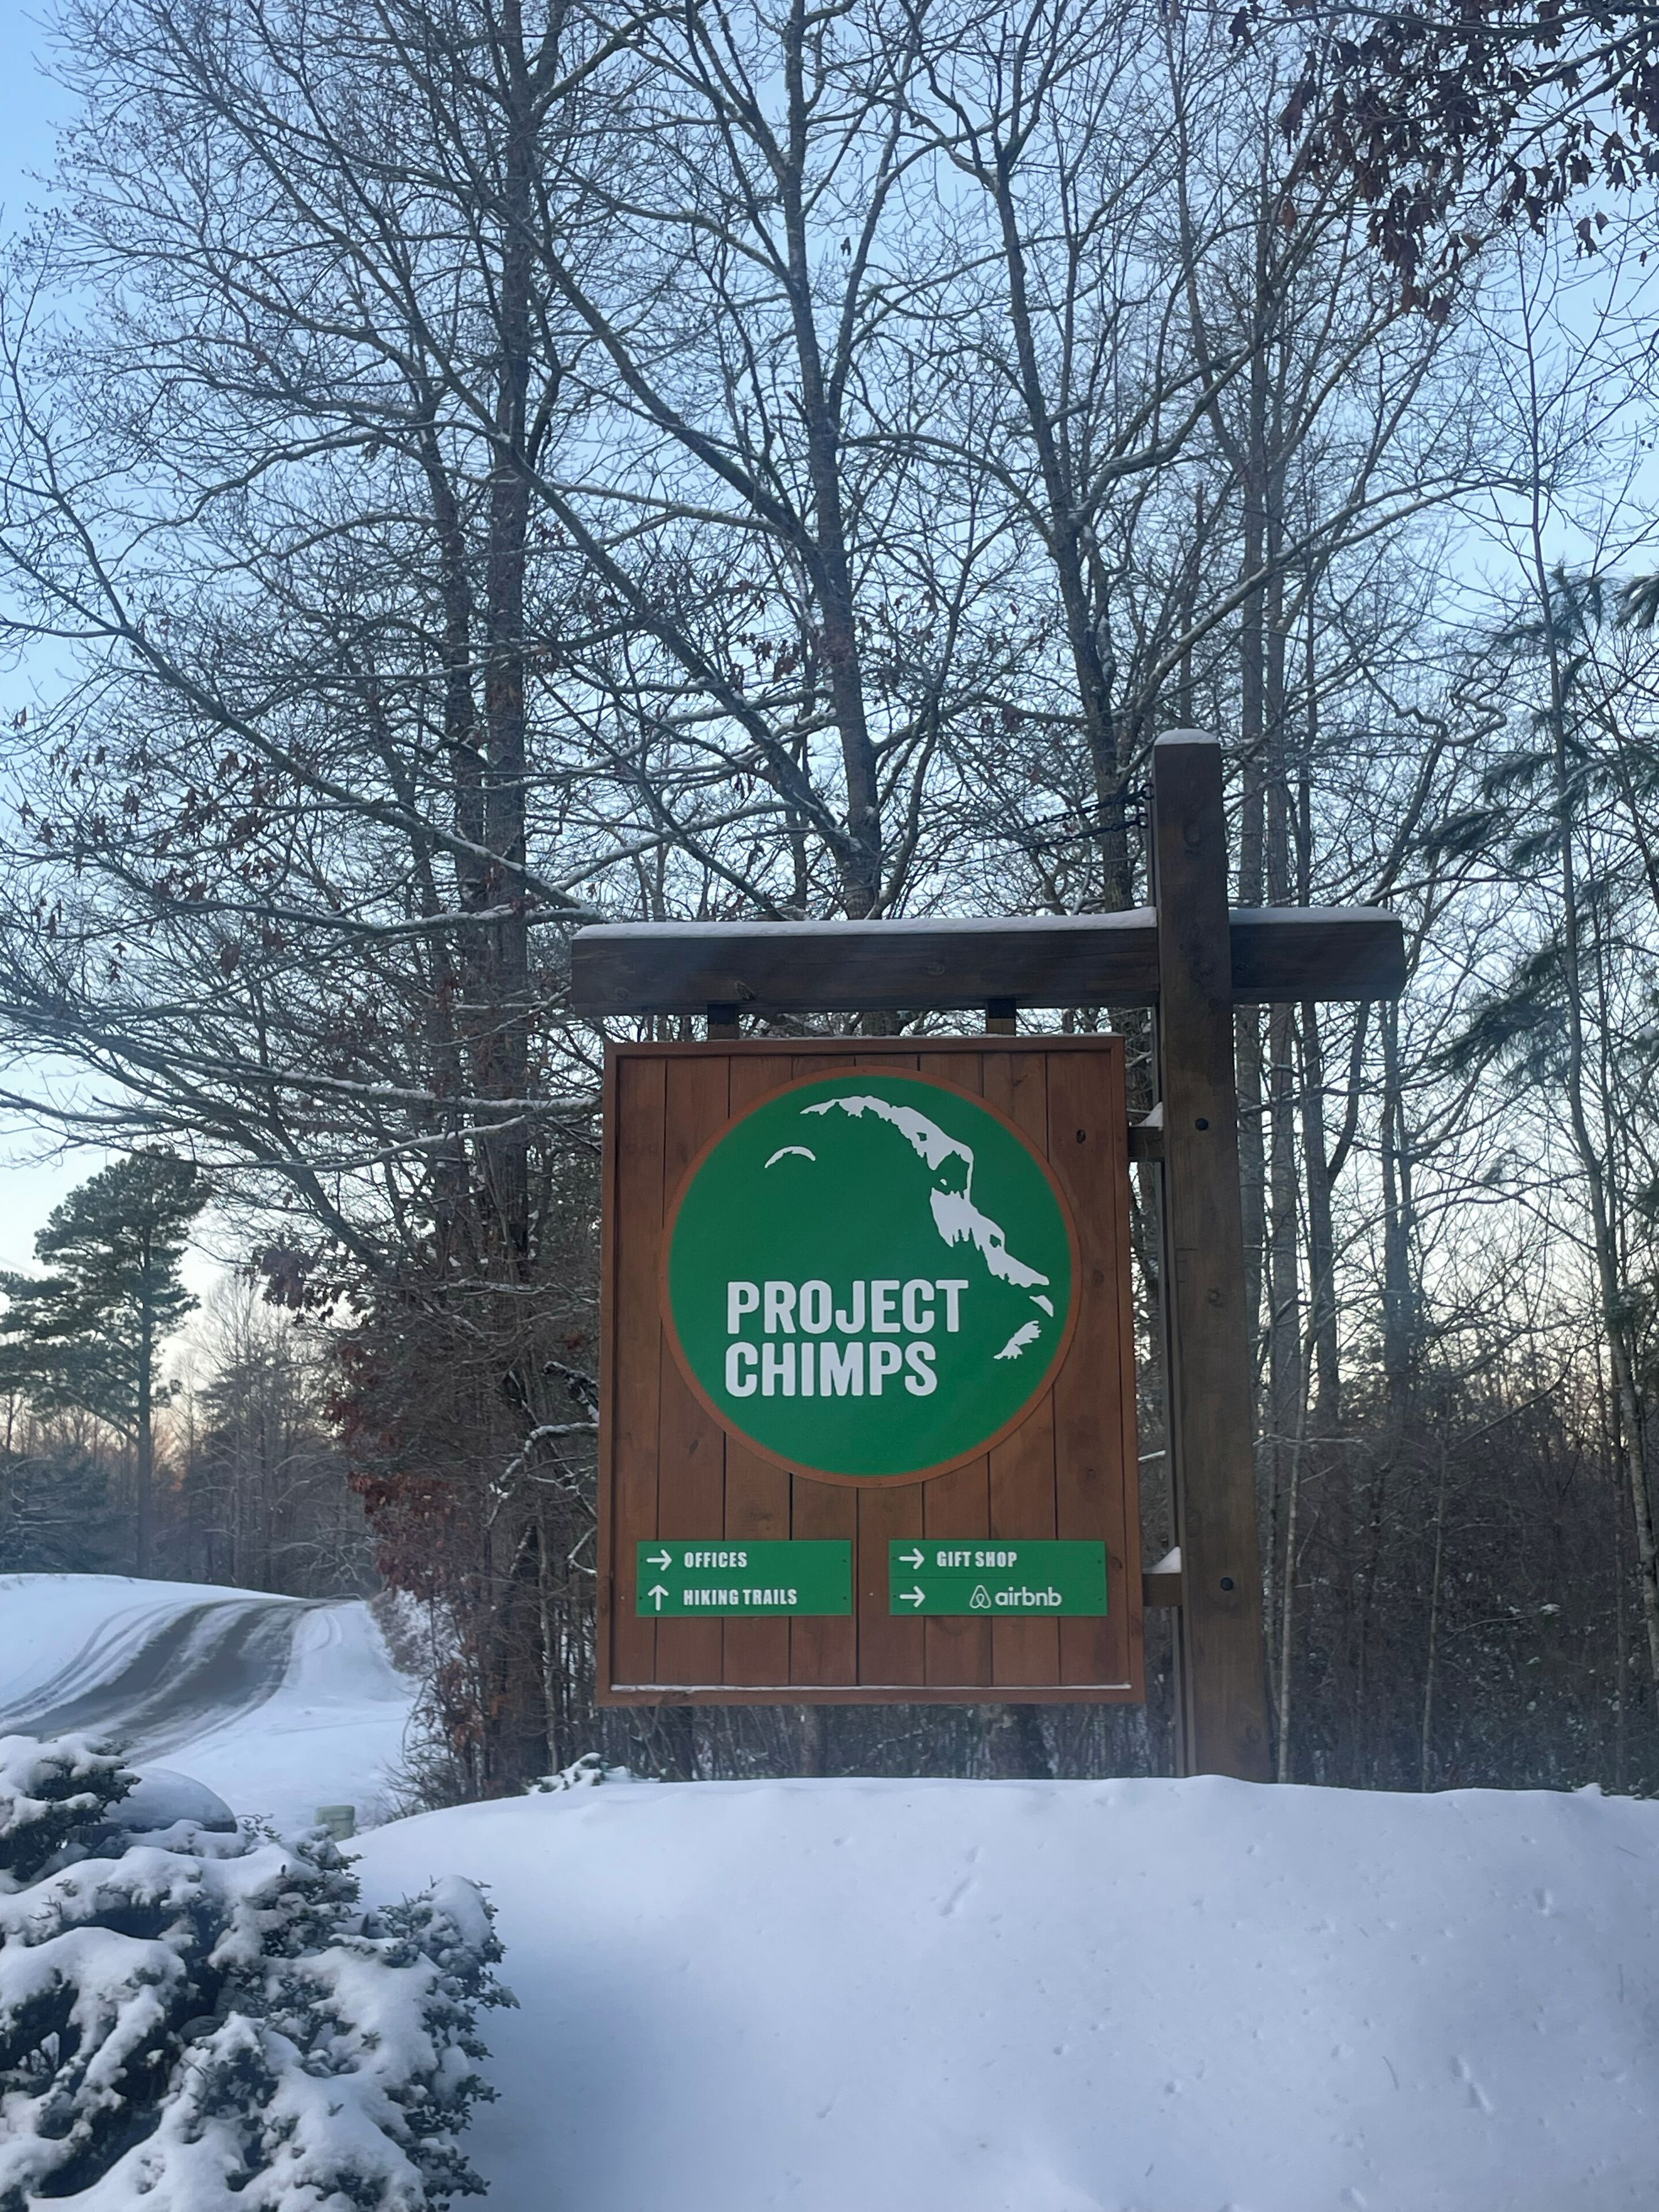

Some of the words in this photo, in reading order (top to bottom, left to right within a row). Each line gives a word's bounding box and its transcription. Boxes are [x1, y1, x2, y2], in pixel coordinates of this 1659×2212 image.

[728, 1279, 968, 1334] PROJECT
[726, 1342, 937, 1396] CHIMPS
[685, 1552, 747, 1567] OFFICES
[937, 1551, 971, 1566] GIFT
[975, 1552, 1017, 1567] SHOP
[684, 1589, 738, 1605] HIKING
[743, 1589, 797, 1604] TRAILS
[995, 1587, 1062, 1606] airbnb
